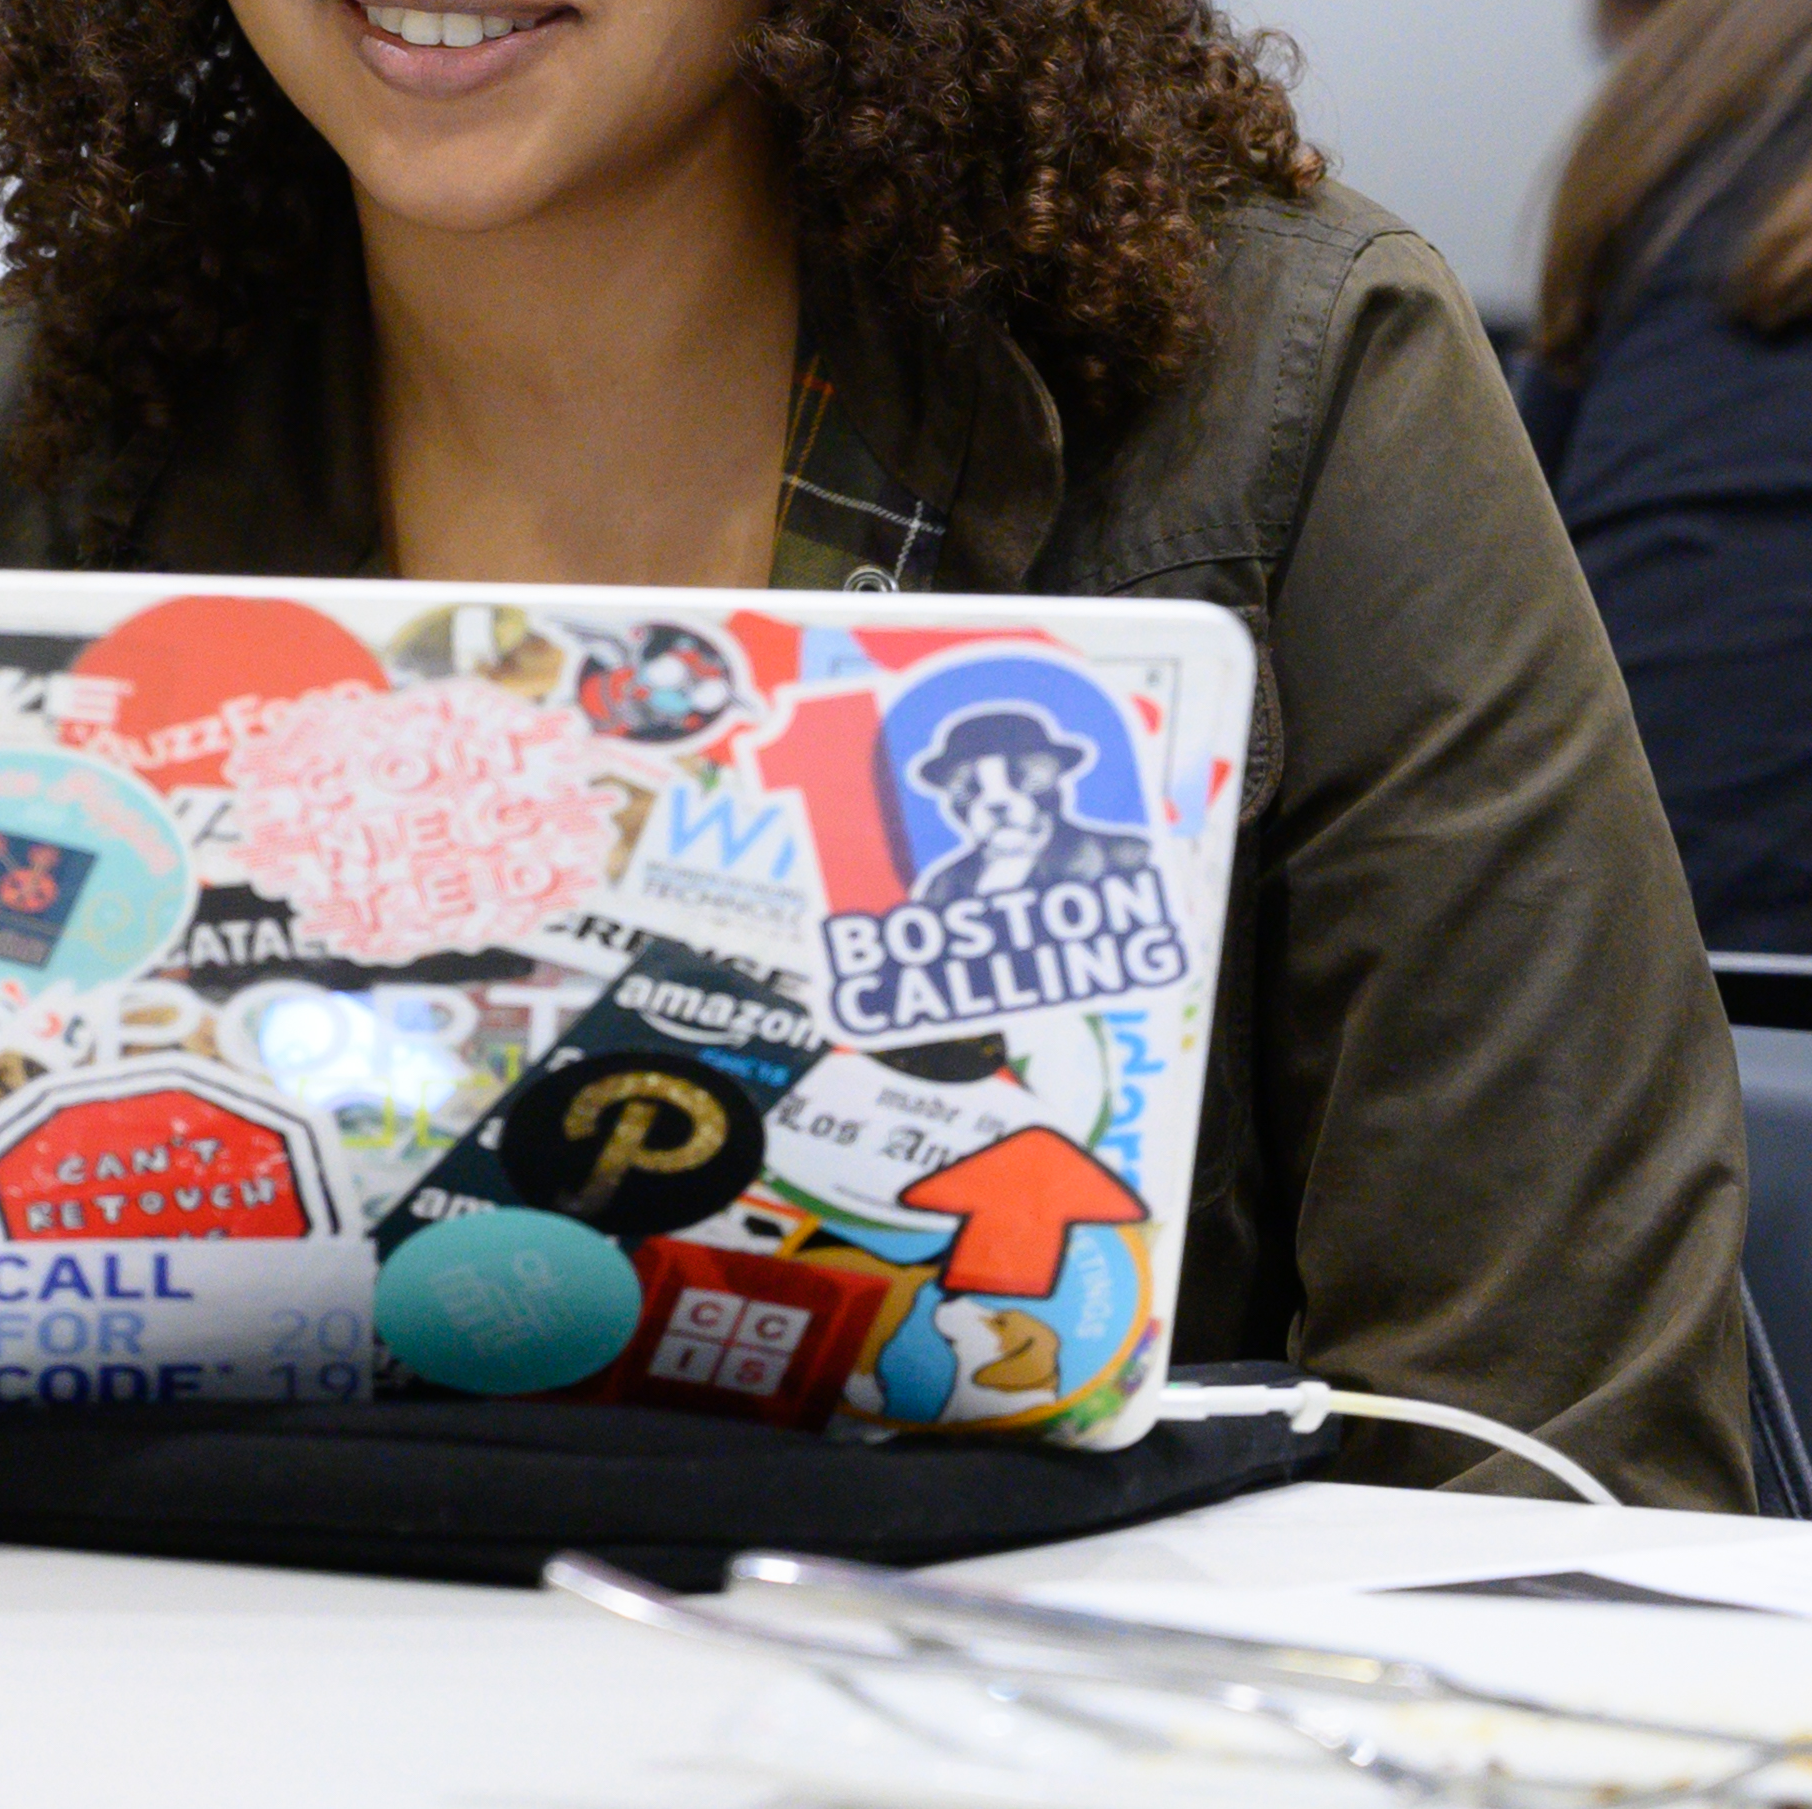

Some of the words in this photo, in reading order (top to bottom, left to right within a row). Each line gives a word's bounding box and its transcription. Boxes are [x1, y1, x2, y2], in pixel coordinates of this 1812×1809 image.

[829, 869, 1169, 976] BOSTON
[831, 931, 1181, 1033] CALLING
[614, 972, 829, 1054] amazon
[774, 1091, 863, 1146] Los
[57, 1134, 224, 1185] CAN'T
[25, 1175, 278, 1232] RETOUCH
[270, 1307, 363, 1360] 20
[271, 1362, 361, 1405] 19
